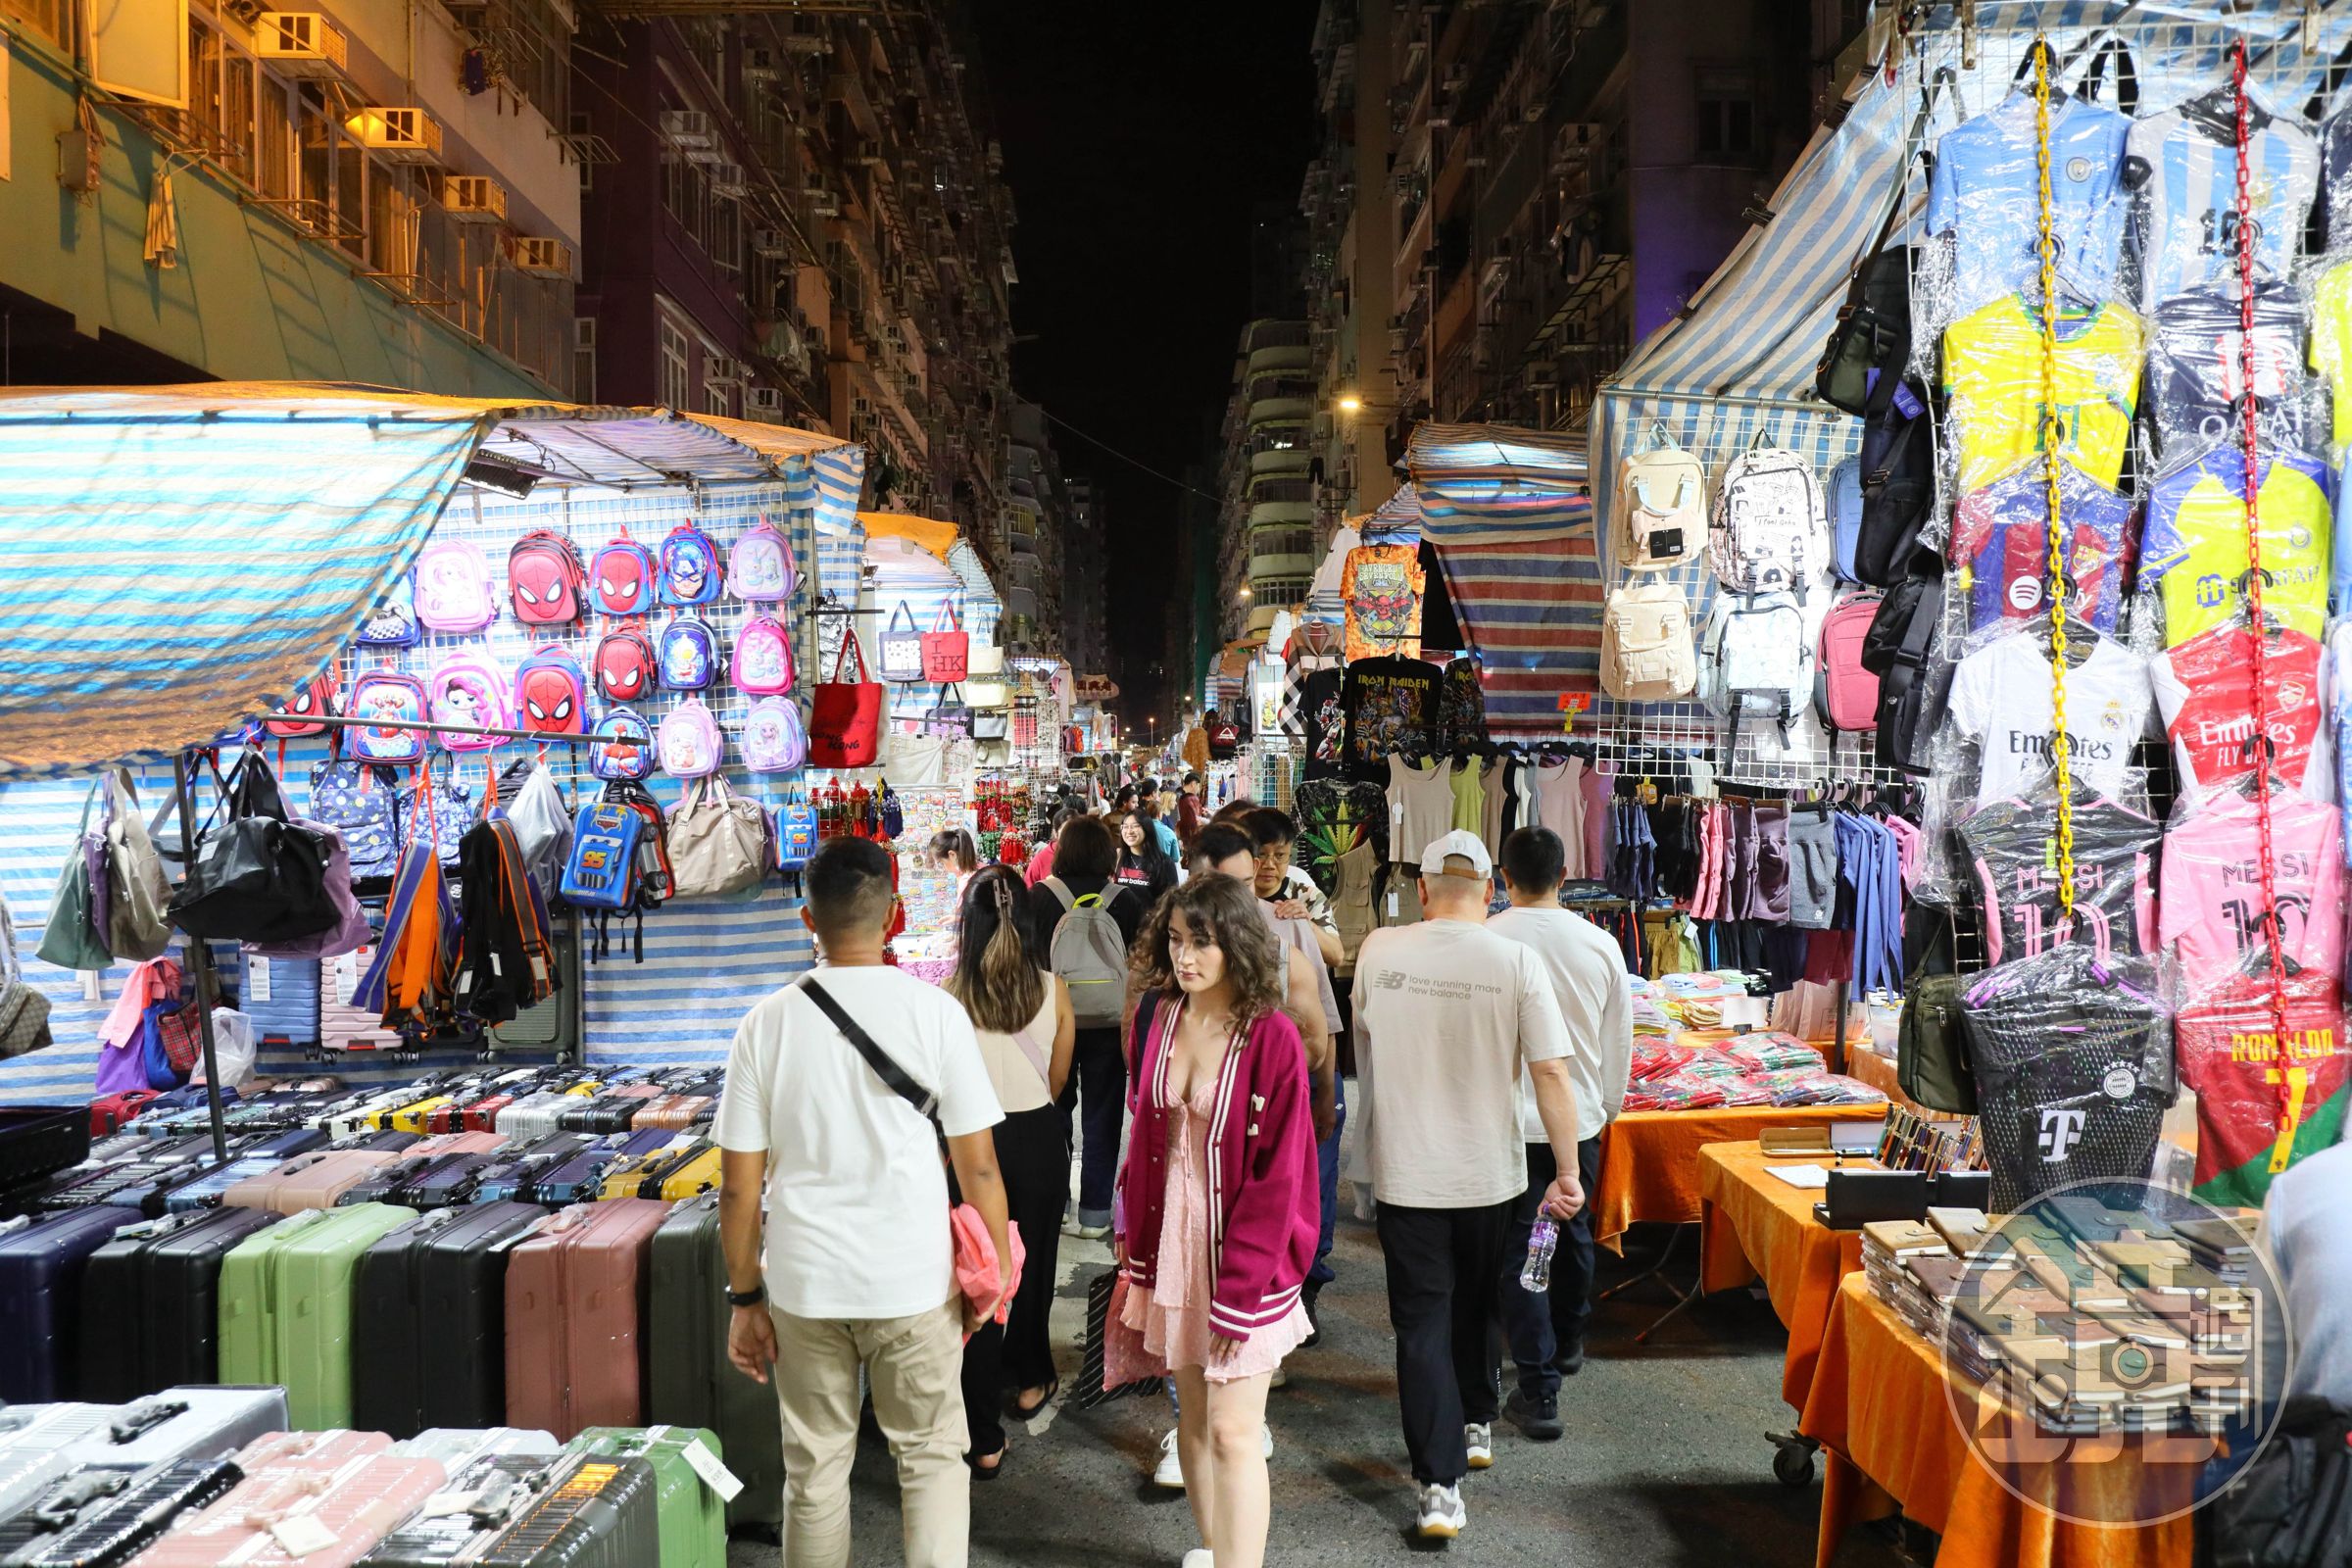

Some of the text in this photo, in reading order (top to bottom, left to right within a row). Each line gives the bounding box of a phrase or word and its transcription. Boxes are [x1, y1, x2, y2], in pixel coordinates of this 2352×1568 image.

[932, 640, 941, 655] I
[932, 655, 965, 672] HK
[1358, 673, 1430, 691] IRON MAIDEN
[1454, 671, 1473, 682] IRO
[2009, 729, 2113, 760] Emtes
[2217, 745, 2240, 767] FLY
[580, 850, 608, 870] 95
[2222, 852, 2310, 888] MESI
[2017, 863, 2104, 894] MSI
[2013, 901, 2111, 960] 10
[1408, 986, 1472, 1001] new balance
[1409, 975, 1502, 995] love running more
[2265, 1066, 2309, 1174] 7
[2038, 1109, 2086, 1162] T
